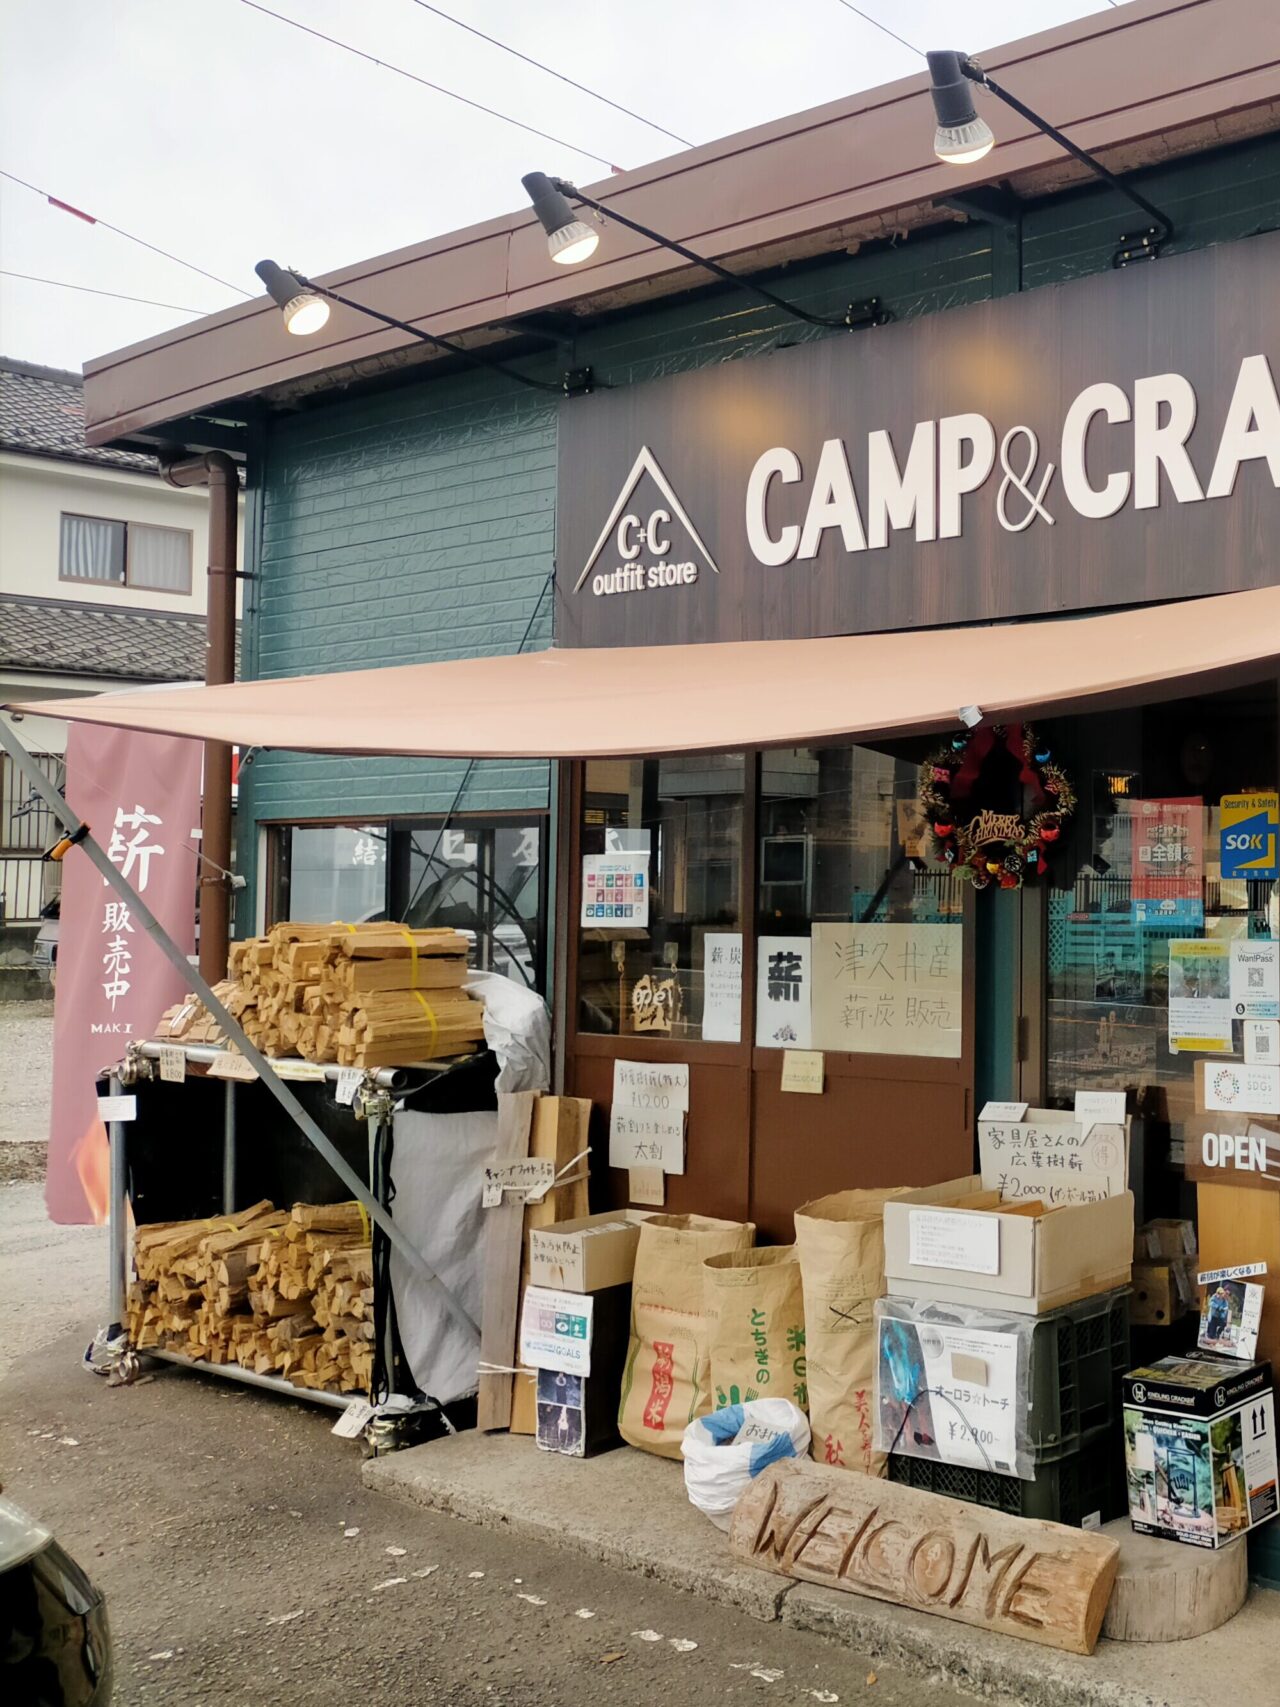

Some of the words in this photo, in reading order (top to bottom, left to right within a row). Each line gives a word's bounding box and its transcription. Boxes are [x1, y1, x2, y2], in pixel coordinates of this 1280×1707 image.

[617, 509, 671, 560] C+C
[592, 563, 646, 596] outfit
[648, 561, 698, 588] store
[981, 809, 1020, 826] MERRY
[1224, 799, 1249, 810] Security
[1258, 798, 1277, 809] Safety
[968, 816, 1025, 845] CHRISTMAS
[102, 804, 164, 892] 薪
[101, 902, 135, 1012] 販売中
[835, 938, 952, 983] 津久井産
[1238, 954, 1273, 963] Wan!Pass
[768, 951, 802, 1002] 薪
[841, 994, 895, 1029] 薪・炭
[905, 997, 953, 1029] 販売
[91, 1024, 133, 1034] MAKI
[1248, 1081, 1272, 1092] SDGs
[634, 1141, 663, 1160] 太割
[988, 1128, 1079, 1150] 家具屋さんの
[1202, 1132, 1267, 1172] OPEN
[1011, 1151, 1083, 1172] 広葉樹薪
[751, 1308, 770, 1384] とちぎの
[1148, 1392, 1170, 1401] KINDLING
[1171, 1395, 1195, 1404] CRACKER
[752, 1480, 1060, 1628] WELCOME
